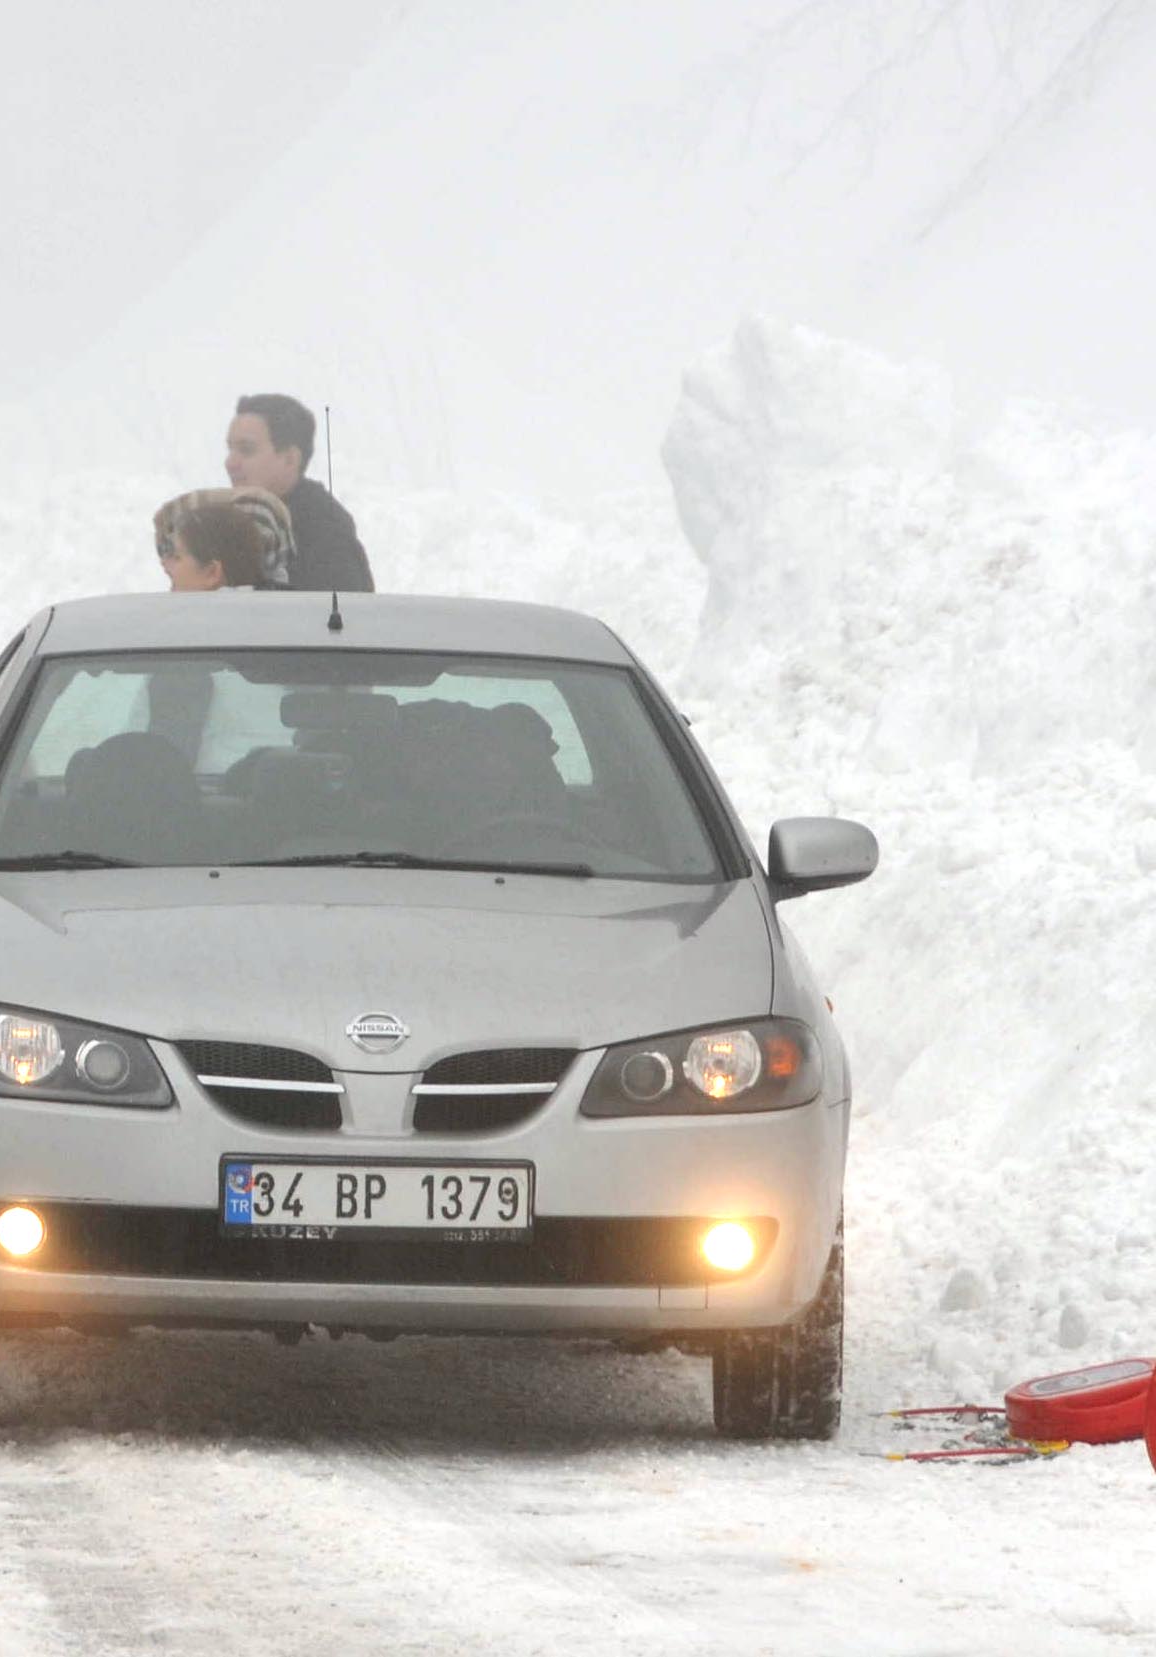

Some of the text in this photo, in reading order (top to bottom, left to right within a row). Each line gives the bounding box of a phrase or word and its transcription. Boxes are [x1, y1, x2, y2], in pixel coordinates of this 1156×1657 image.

[352, 1024, 404, 1033] NISSAN
[253, 1171, 520, 1222] 34 BP 1379
[230, 1199, 250, 1214] TR
